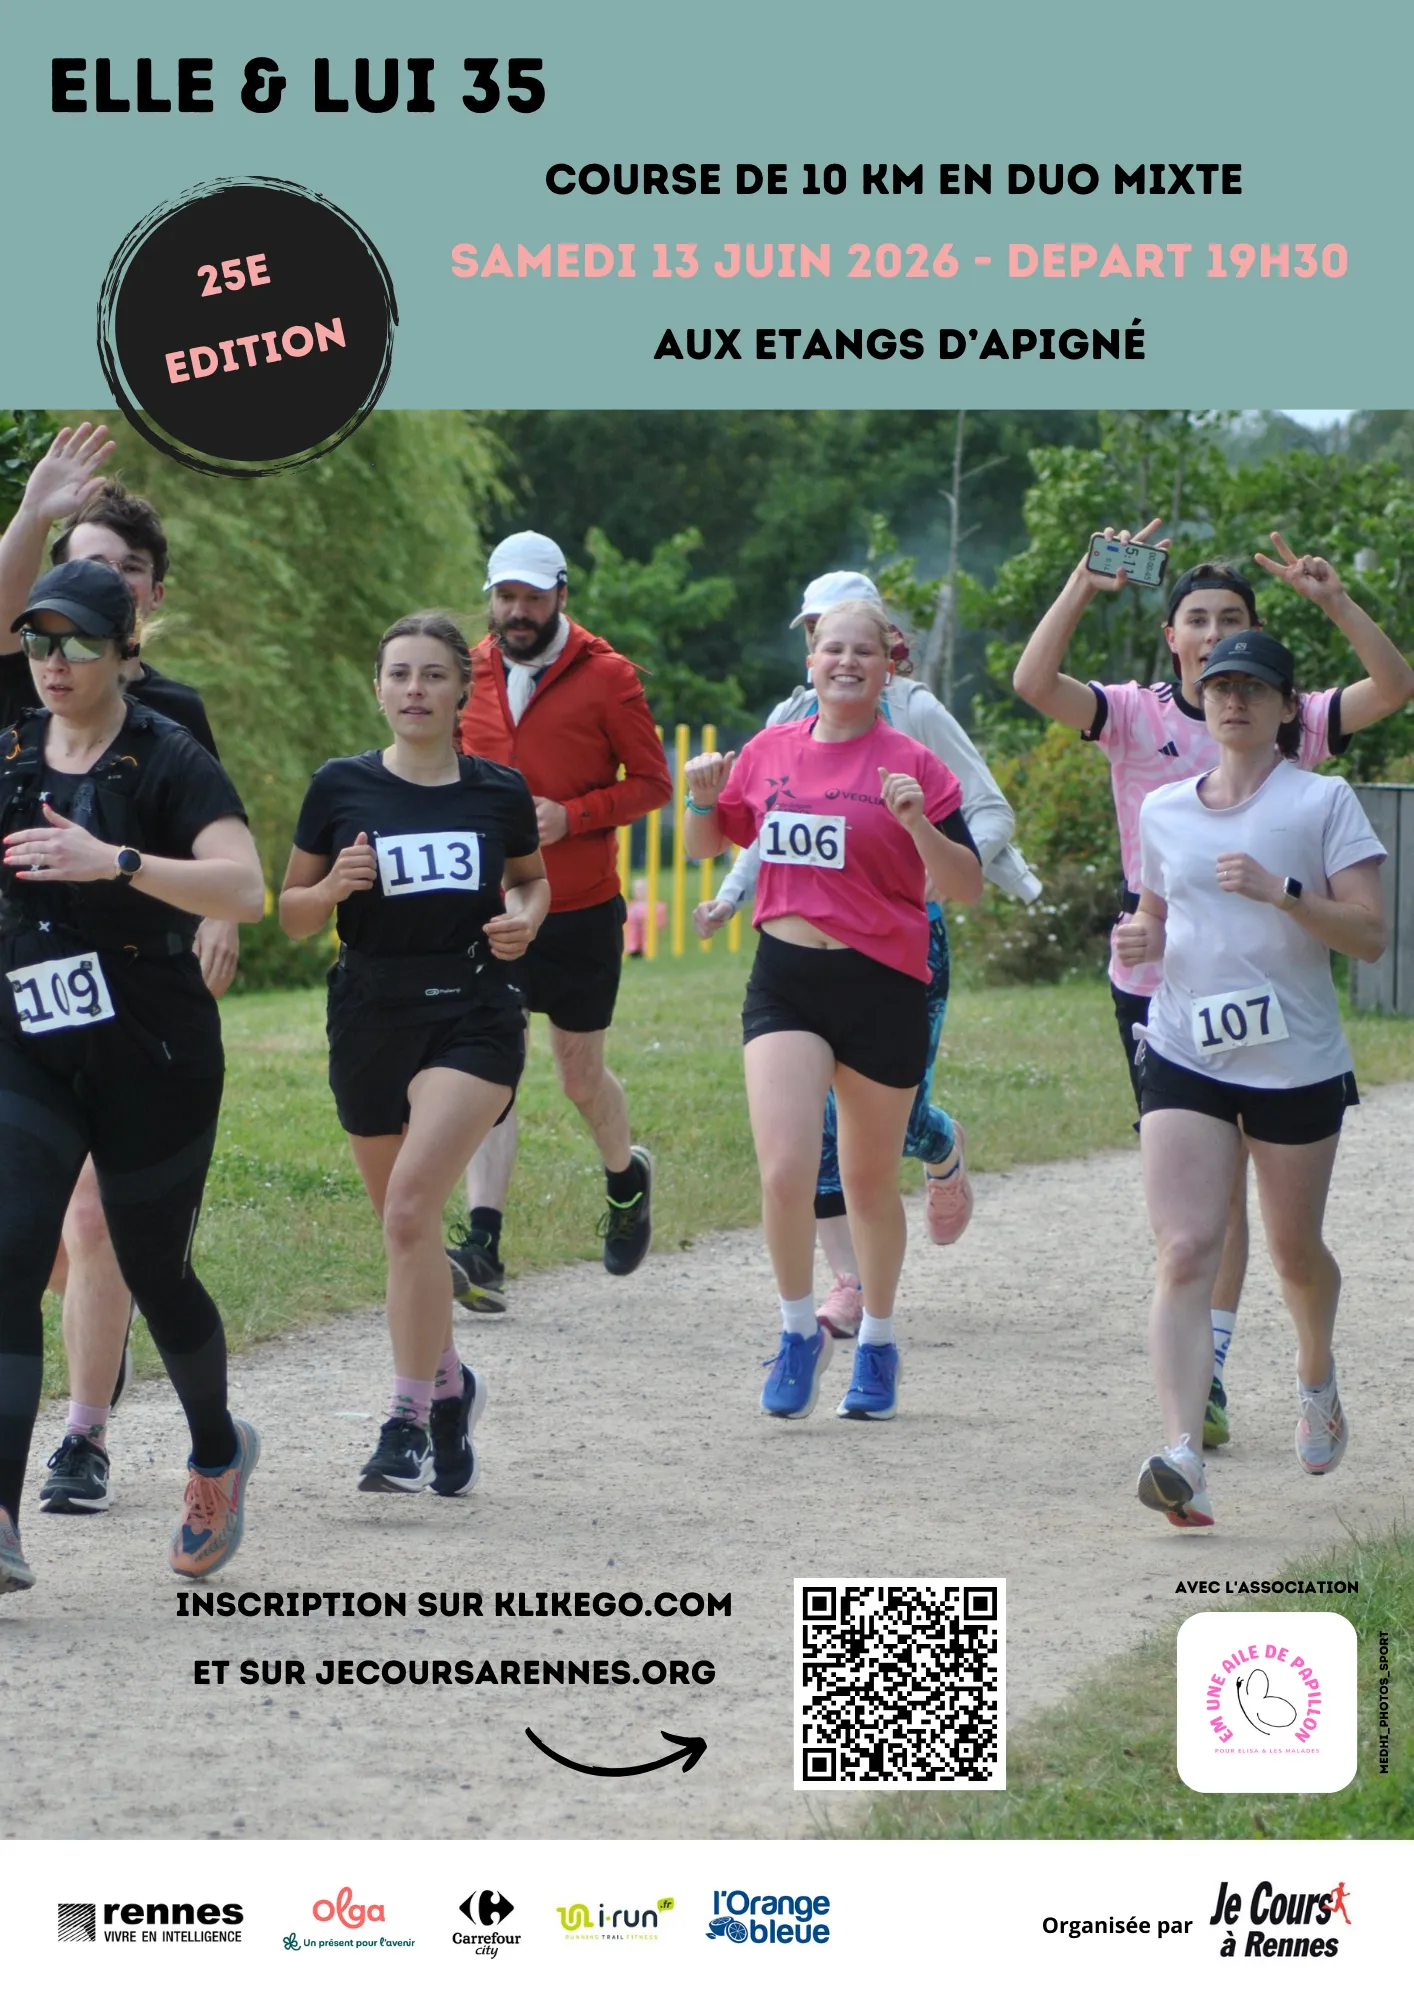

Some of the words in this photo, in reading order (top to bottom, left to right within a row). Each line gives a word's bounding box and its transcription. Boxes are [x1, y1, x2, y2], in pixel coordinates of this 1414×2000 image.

[387, 842, 473, 887] 113
[766, 821, 838, 861] 106
[20, 968, 99, 1023] 109
[1198, 995, 1271, 1047] 107
